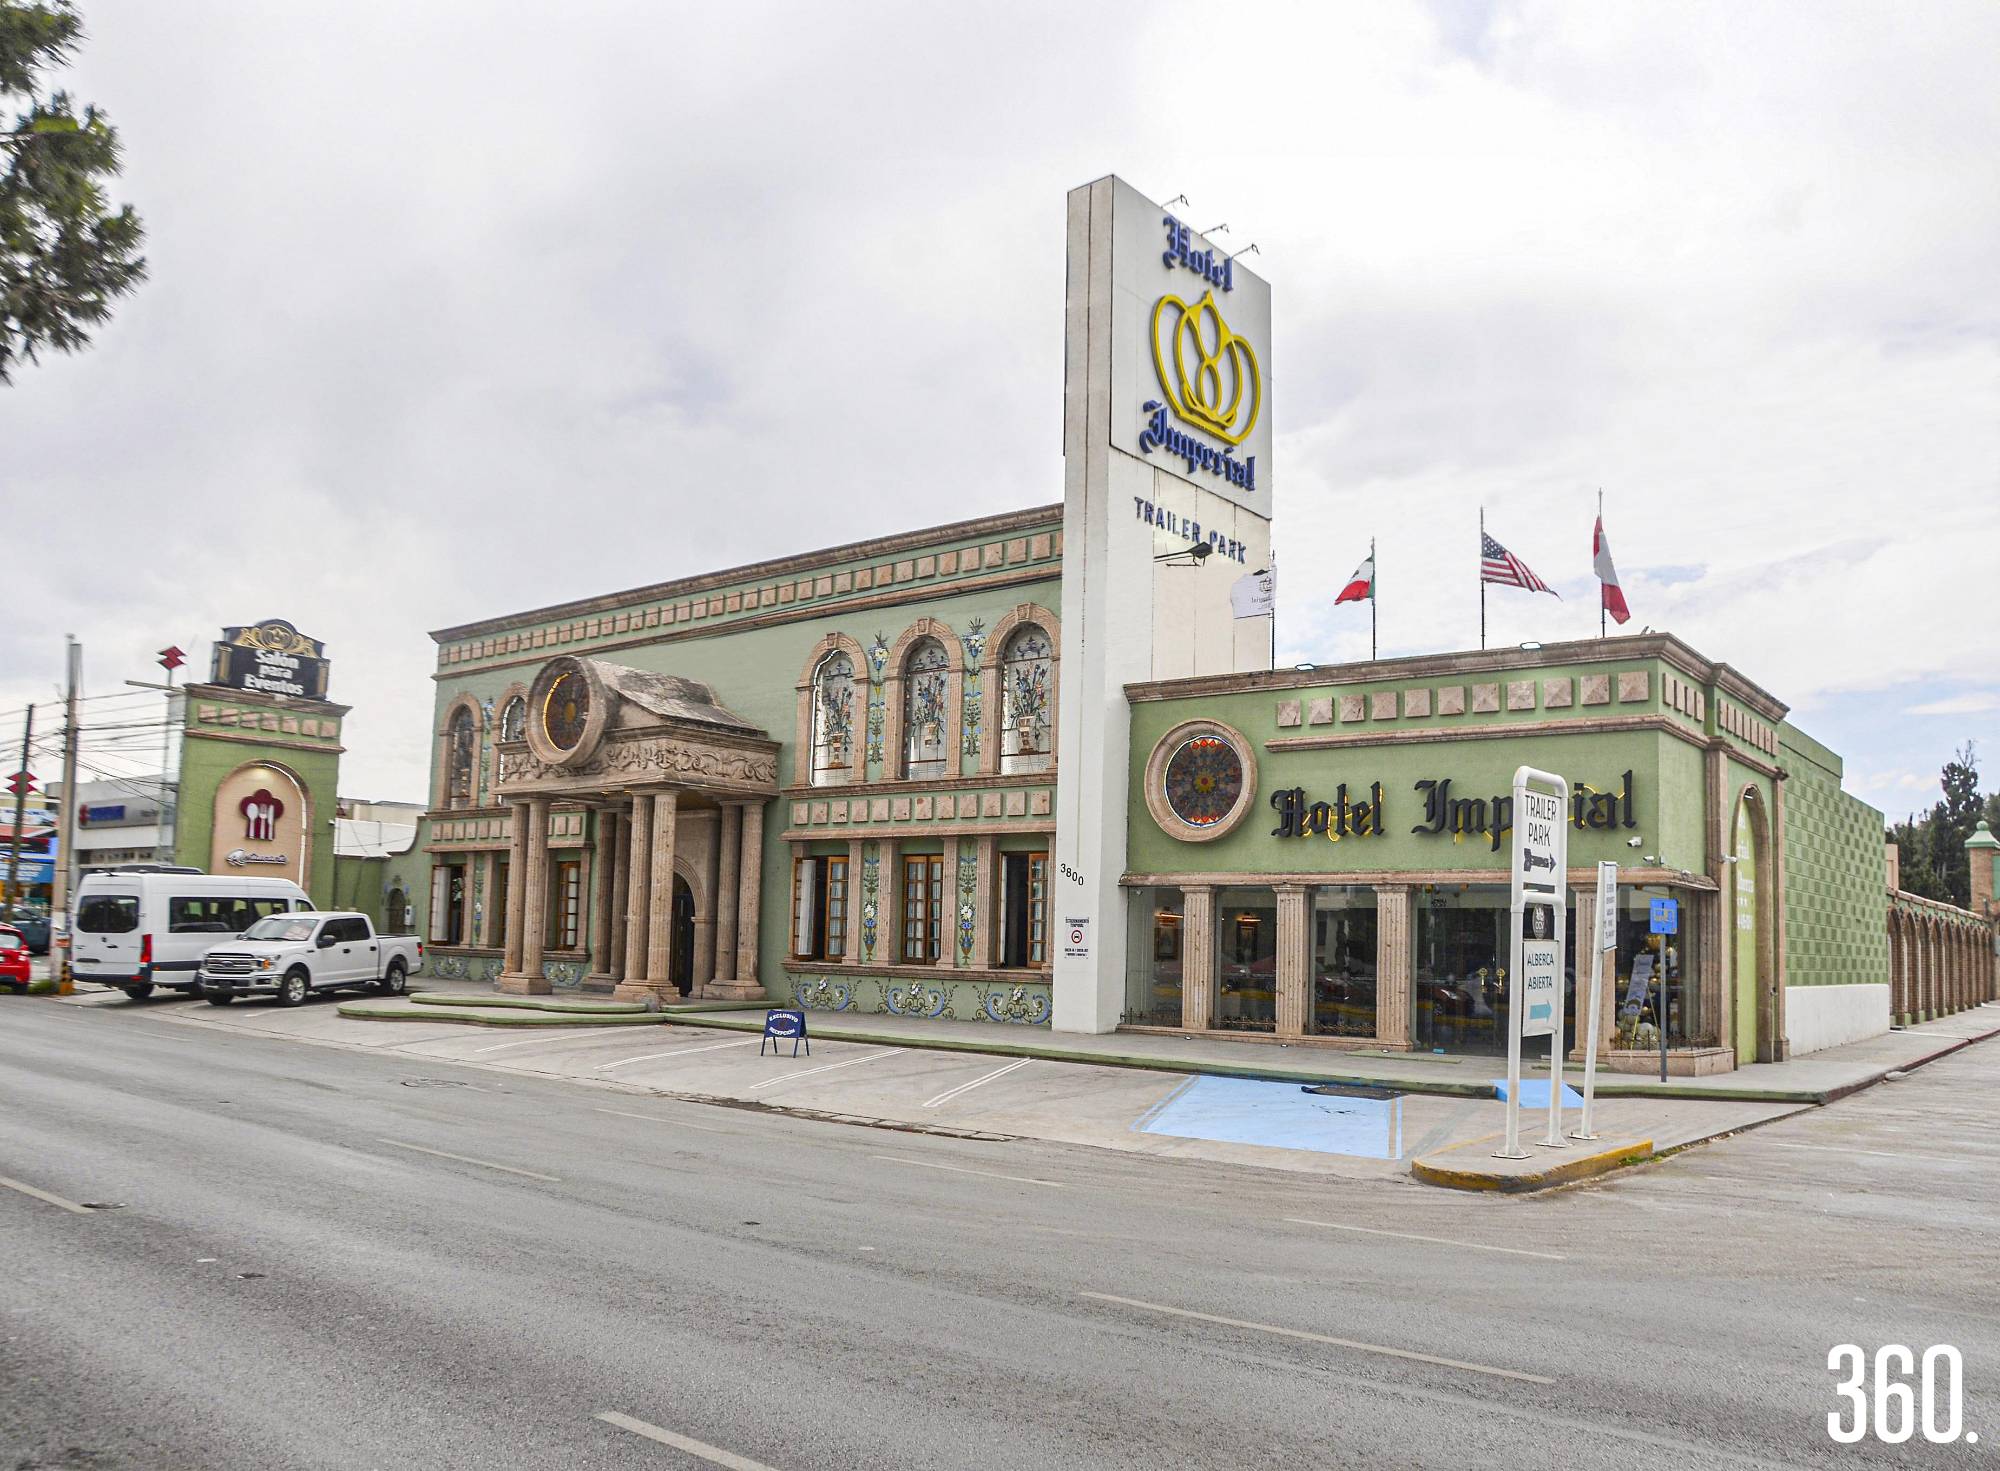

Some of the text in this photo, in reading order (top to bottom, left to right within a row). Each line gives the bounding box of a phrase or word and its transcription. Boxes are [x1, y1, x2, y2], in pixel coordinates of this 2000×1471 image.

[1162, 215, 1233, 292] Hotel
[1139, 400, 1255, 491] Imperial
[1134, 497, 1246, 564] TRAILER PARK
[255, 650, 299, 669] Salón
[244, 673, 304, 695] Eventos
[258, 666, 293, 679] para
[1271, 769, 1637, 852] Hotel Impial
[1525, 794, 1557, 821] TRAILER
[1528, 822, 1551, 847] PARK
[1060, 863, 1084, 886] 3800
[1527, 953, 1555, 967] ALBERCA
[1527, 975, 1553, 990] ABIERTA
[768, 1013, 799, 1023] EXCLUSIVO
